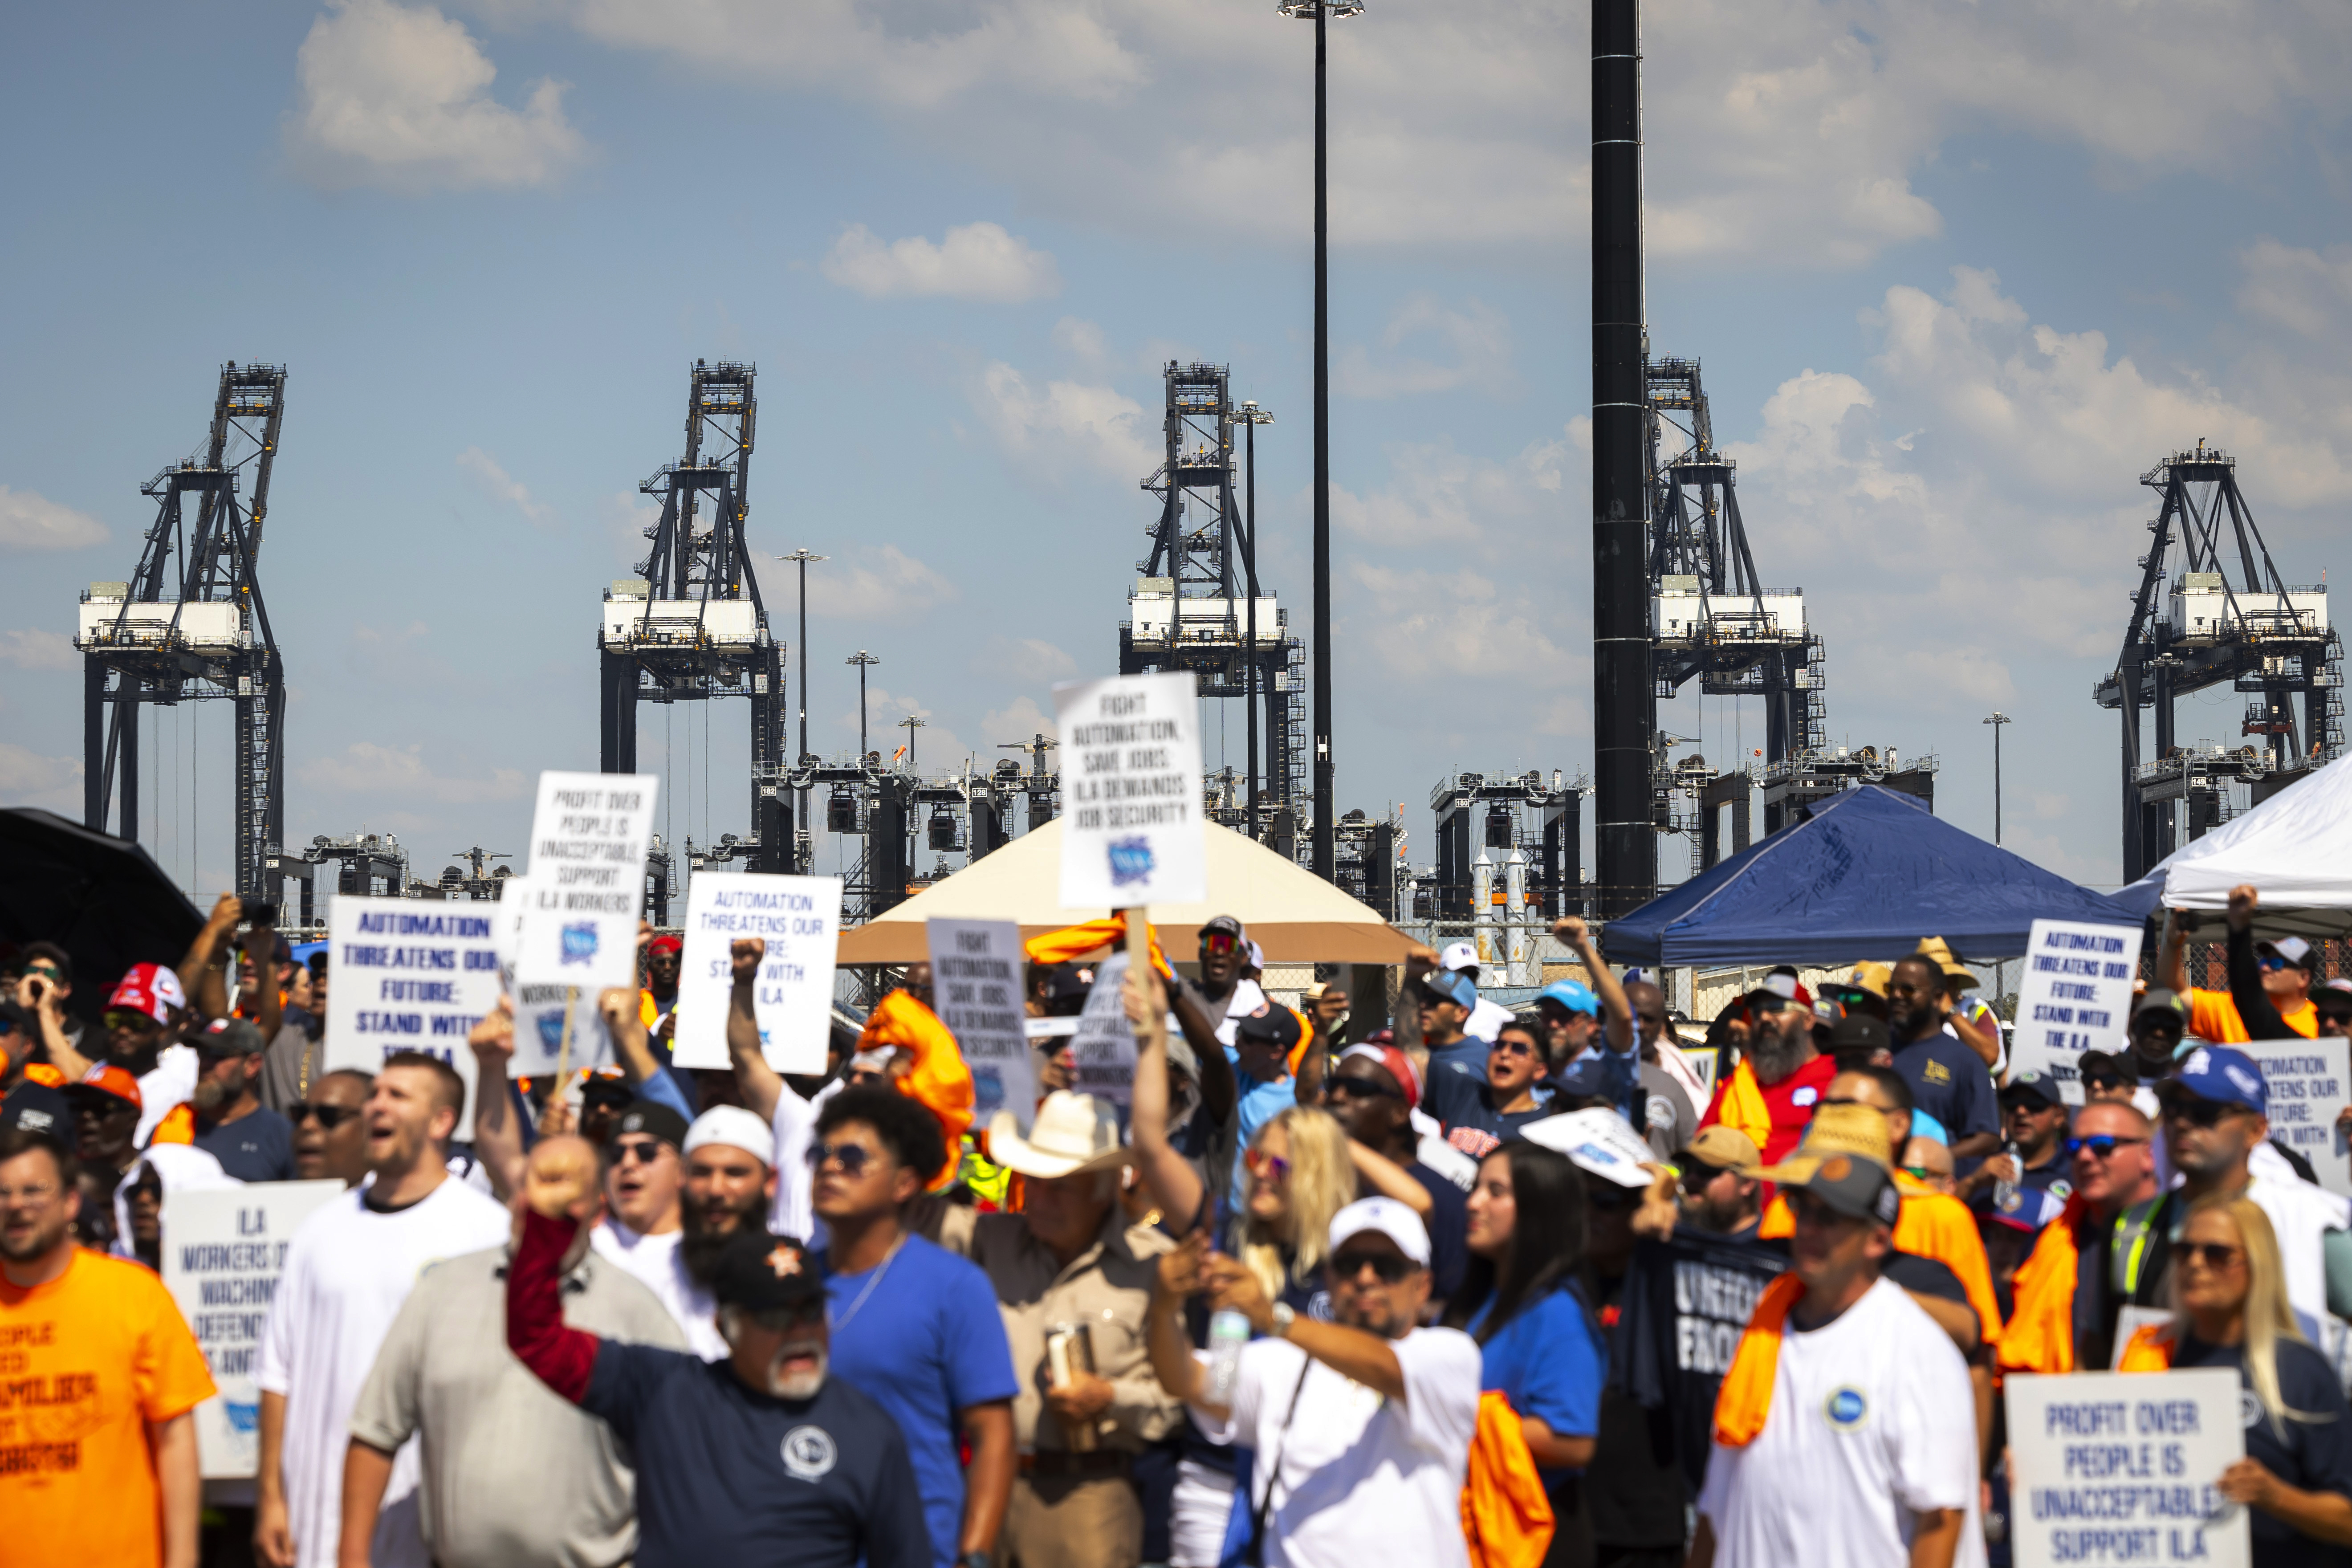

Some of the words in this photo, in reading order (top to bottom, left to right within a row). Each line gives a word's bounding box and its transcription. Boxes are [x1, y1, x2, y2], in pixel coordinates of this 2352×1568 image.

[714, 891, 814, 912] AUTOMATION
[358, 911, 492, 938] AUTOMATION
[700, 912, 787, 934] THREATENS
[792, 917, 823, 936] OUR
[2044, 930, 2126, 955] AUTOMATION
[343, 943, 456, 969] THREATENS
[2031, 954, 2100, 977] THREATENS
[2103, 961, 2129, 981] OUR
[765, 963, 805, 981] WITH
[354, 1010, 423, 1035] STAND
[2033, 1003, 2074, 1024] STAND
[2077, 1008, 2112, 1028] WITH
[2045, 1029, 2067, 1048] THE
[2311, 1079, 2339, 1099] OUR
[180, 1241, 269, 1274] WORKERS
[2046, 1402, 2127, 1437] PROFIT
[2136, 1400, 2201, 1434] OVER
[2064, 1443, 2154, 1478] PEOPLE
[2162, 1443, 2185, 1476] IS
[2052, 1529, 2158, 1562] SUPPORT
